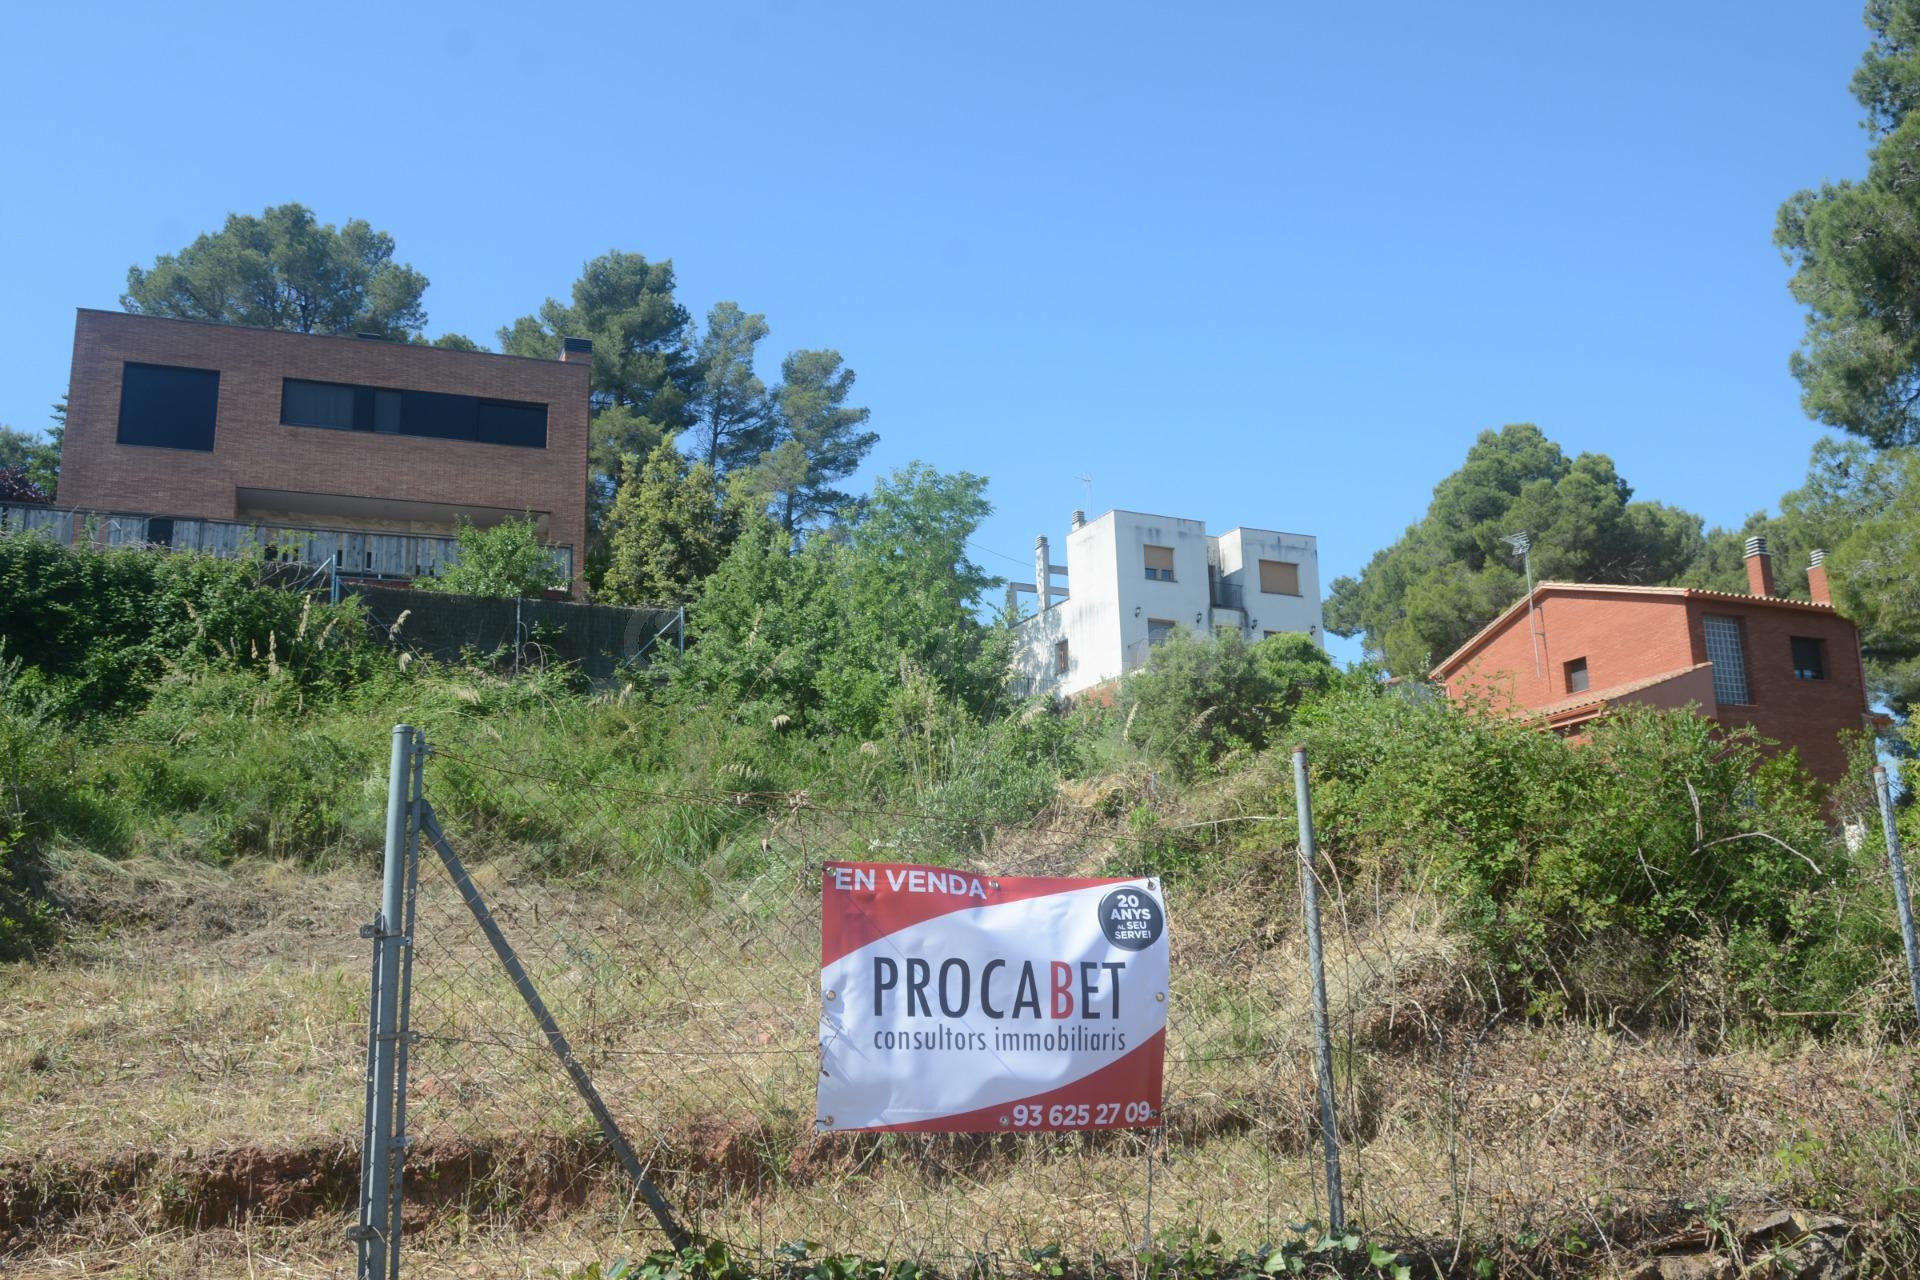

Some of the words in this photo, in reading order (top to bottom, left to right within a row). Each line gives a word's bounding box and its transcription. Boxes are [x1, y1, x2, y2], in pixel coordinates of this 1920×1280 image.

[835, 867, 876, 891] EN
[886, 869, 987, 899] VENDA
[1116, 894, 1139, 908] 20
[1110, 907, 1151, 920] ANYS
[1114, 931, 1152, 939] SERVEI
[1126, 921, 1147, 930] SEU
[873, 956, 1126, 1020] PROCABET
[873, 1023, 987, 1051] consultors
[994, 1025, 1127, 1051] immobiliaris
[1013, 1104, 1043, 1126] 93
[1048, 1104, 1090, 1126] 625
[1095, 1104, 1121, 1124] 27
[1124, 1101, 1151, 1122] 09
